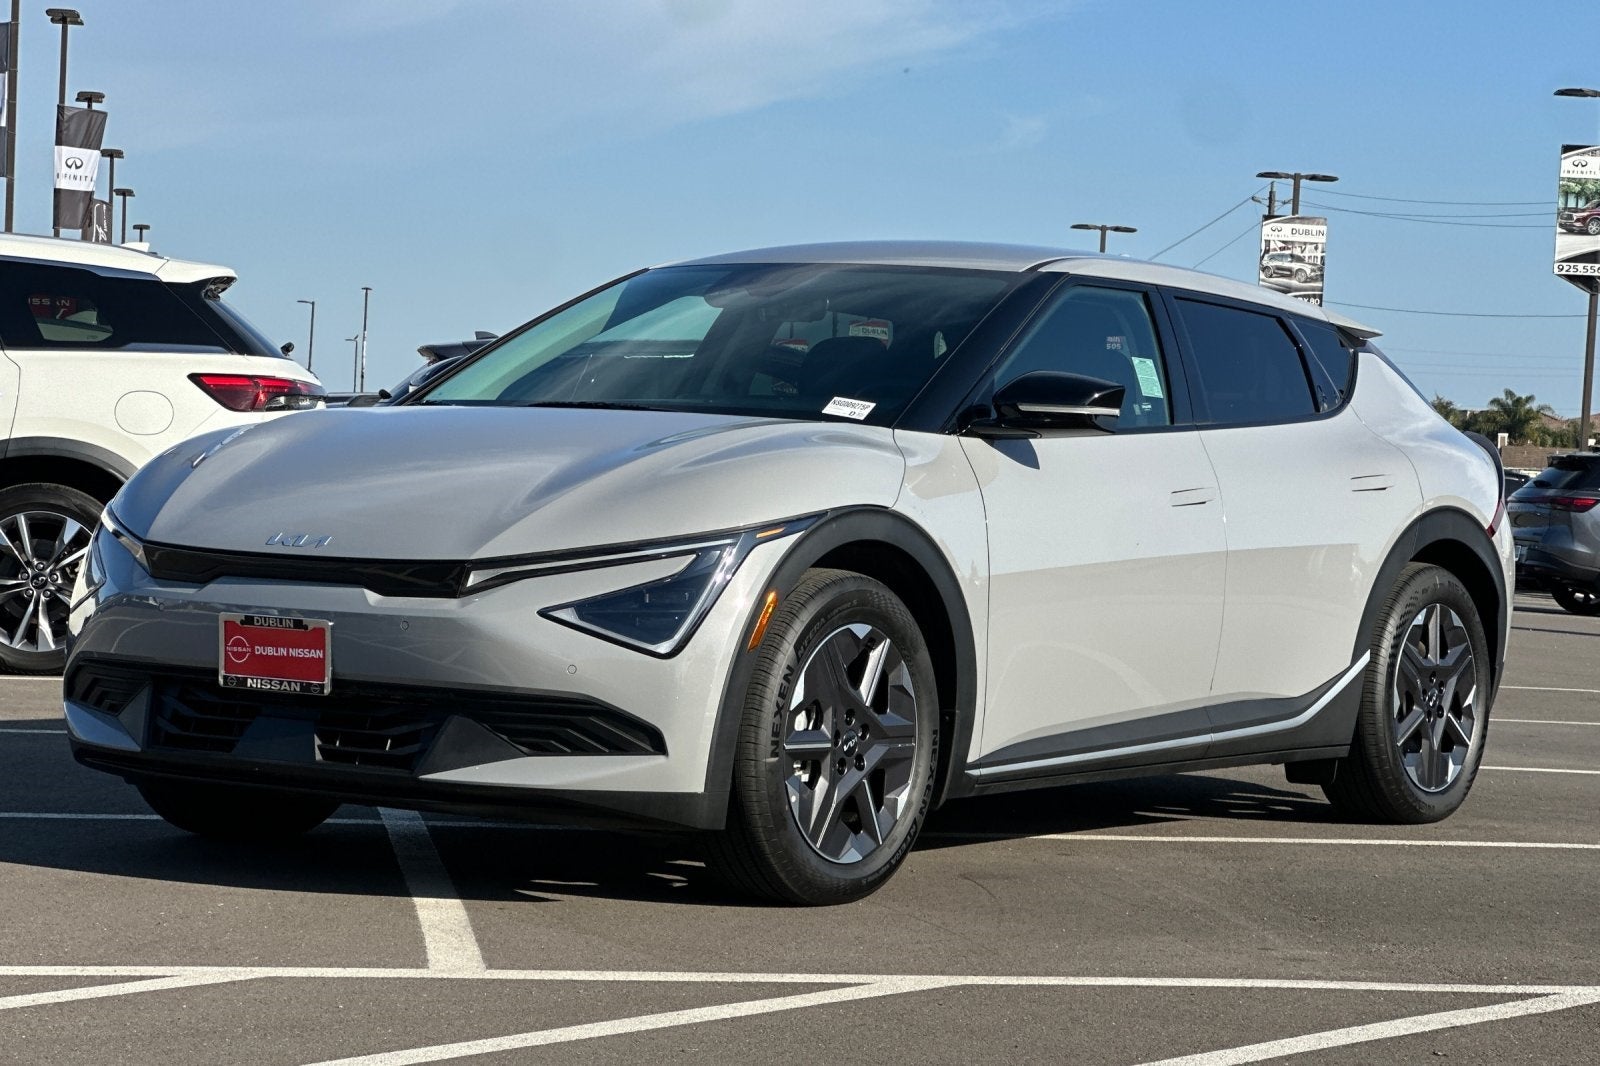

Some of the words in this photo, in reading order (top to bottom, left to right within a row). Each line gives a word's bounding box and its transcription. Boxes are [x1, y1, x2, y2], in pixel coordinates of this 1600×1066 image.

[1291, 228, 1325, 236] DUBLIN
[265, 532, 333, 548] KIA
[253, 616, 294, 628] DUBLIN
[254, 645, 287, 657] DUBLIN
[288, 647, 323, 658] NISSAN
[246, 678, 301, 692] NISSAN
[770, 664, 795, 758] NEXEN
[919, 729, 939, 817] NEXEN
